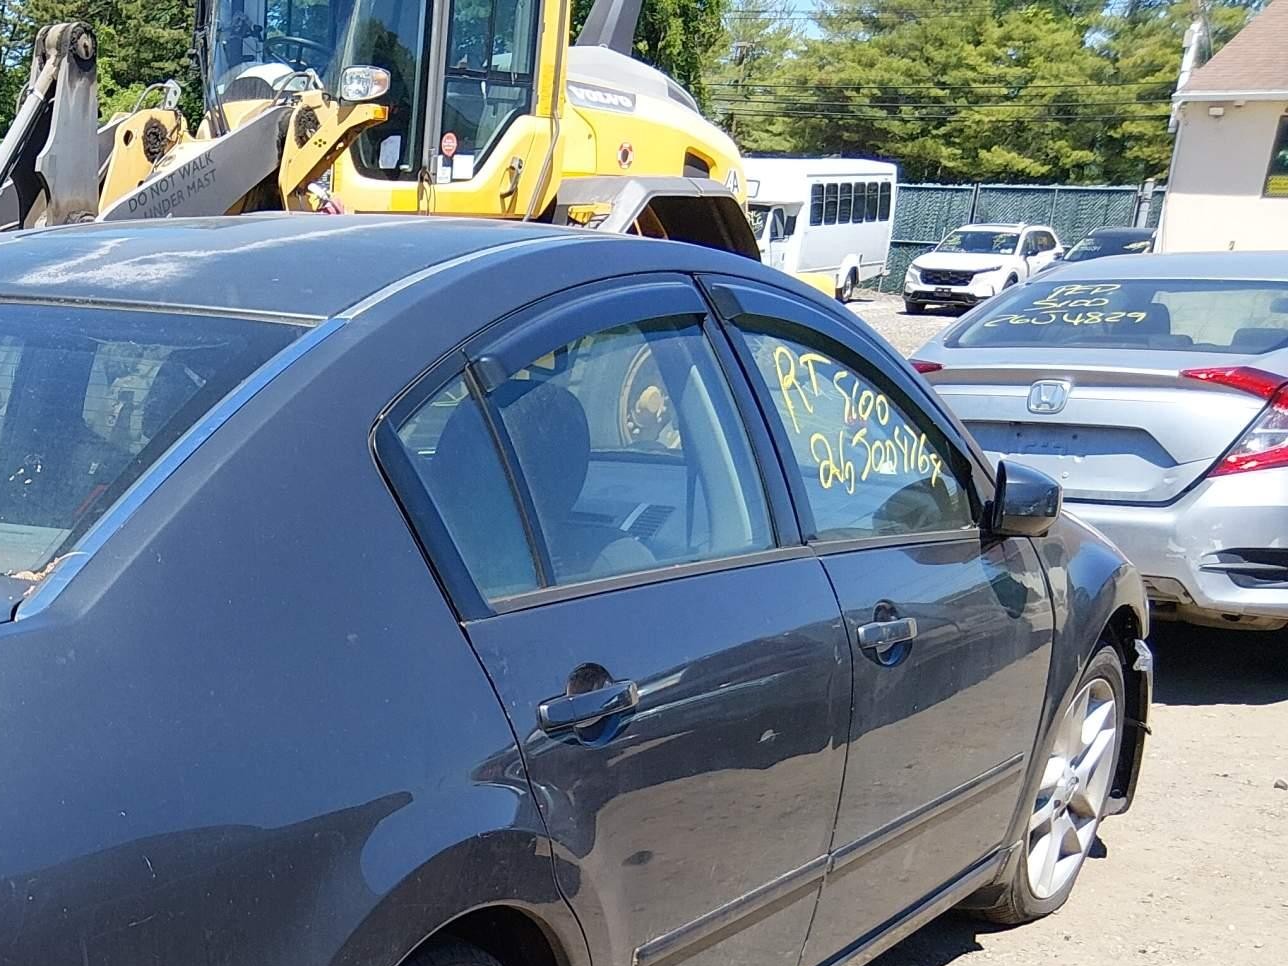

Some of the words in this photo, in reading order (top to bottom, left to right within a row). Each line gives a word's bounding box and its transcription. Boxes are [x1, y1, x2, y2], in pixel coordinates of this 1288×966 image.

[567, 84, 633, 108] VOLVO
[128, 191, 148, 213] DO
[150, 172, 175, 199] NOT
[178, 151, 214, 180] WALK
[187, 168, 217, 198] MAST
[774, 346, 832, 434] RT
